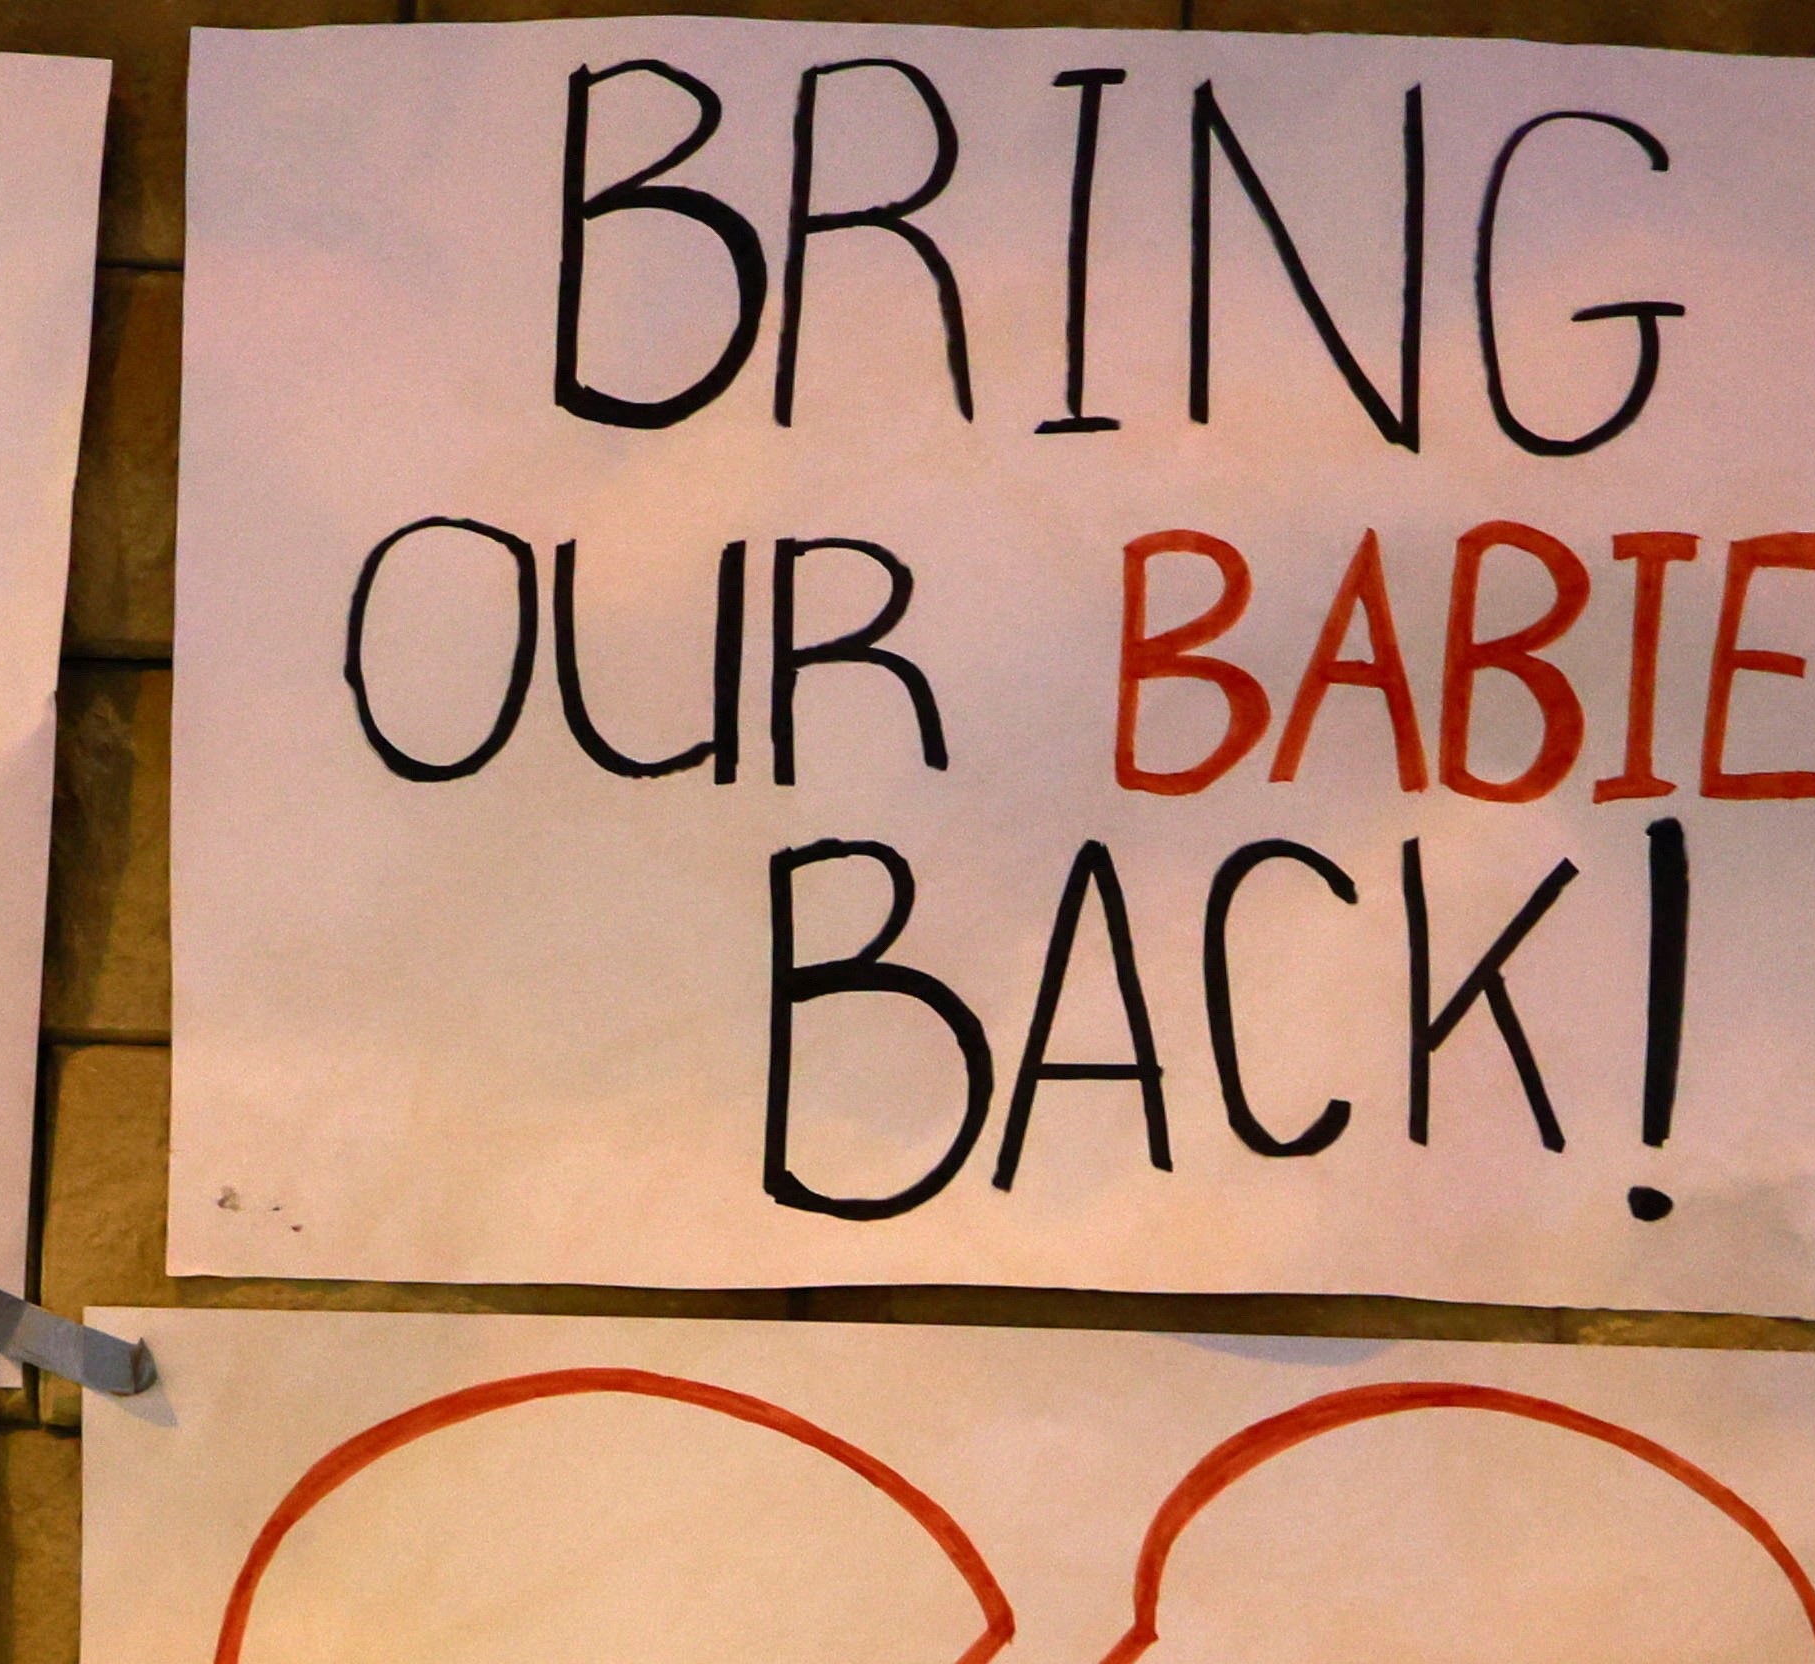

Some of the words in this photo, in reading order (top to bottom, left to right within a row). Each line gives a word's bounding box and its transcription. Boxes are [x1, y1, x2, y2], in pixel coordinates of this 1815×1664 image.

[554, 57, 1688, 458] BRING
[344, 516, 949, 787] OUR
[763, 817, 1691, 1223] BACK!
